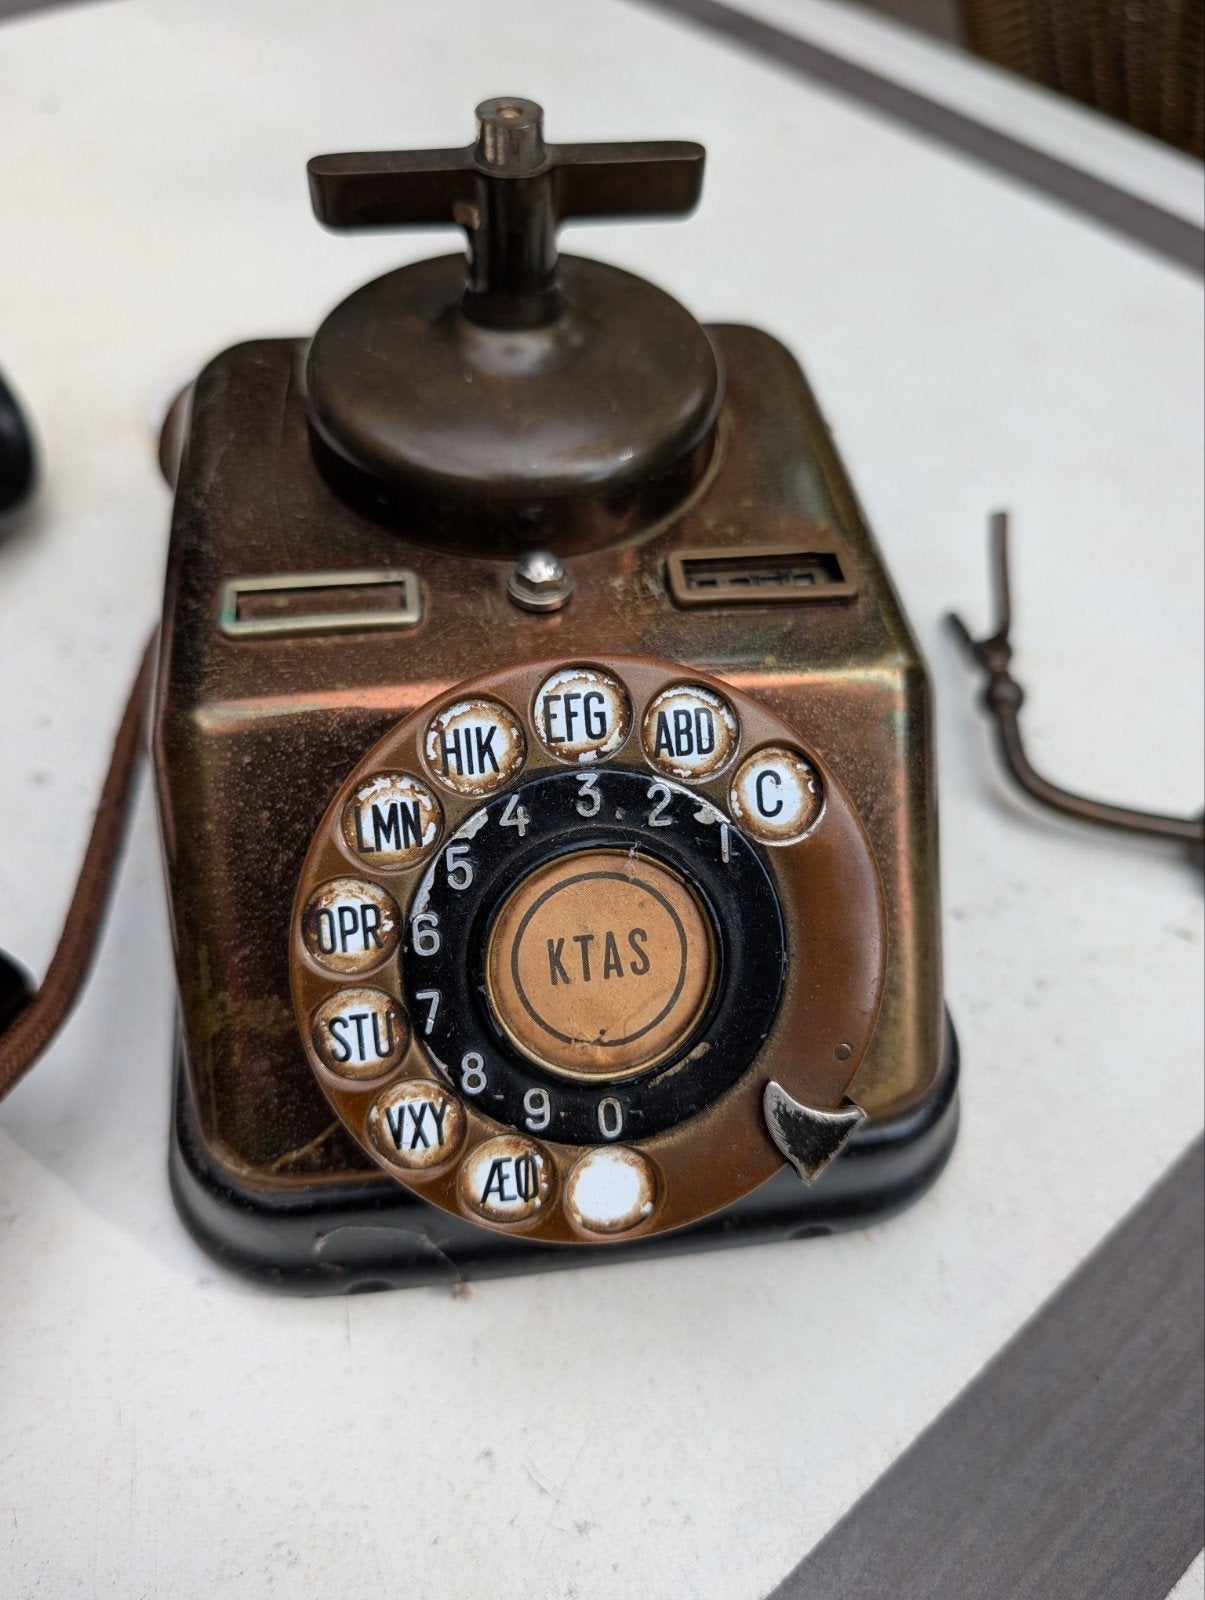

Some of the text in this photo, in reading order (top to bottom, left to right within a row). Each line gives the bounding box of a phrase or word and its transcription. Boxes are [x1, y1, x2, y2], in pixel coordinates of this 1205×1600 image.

[543, 691, 607, 744] EFG
[653, 707, 716, 758] ABD
[439, 725, 499, 776] HIK
[498, 794, 530, 837] 4
[575, 773, 601, 818] 3
[646, 784, 672, 827] 2
[755, 769, 784, 818] C
[353, 801, 423, 853] LMN
[720, 823, 730, 864] 1
[445, 844, 474, 891] 5
[316, 903, 384, 955] OPR
[411, 913, 441, 957] 6
[547, 927, 650, 986] KTAS
[328, 1010, 394, 1063] STU
[415, 990, 441, 1035] 7
[461, 1052, 488, 1095] 8
[385, 1098, 447, 1150] VXY
[523, 1087, 551, 1131] 9
